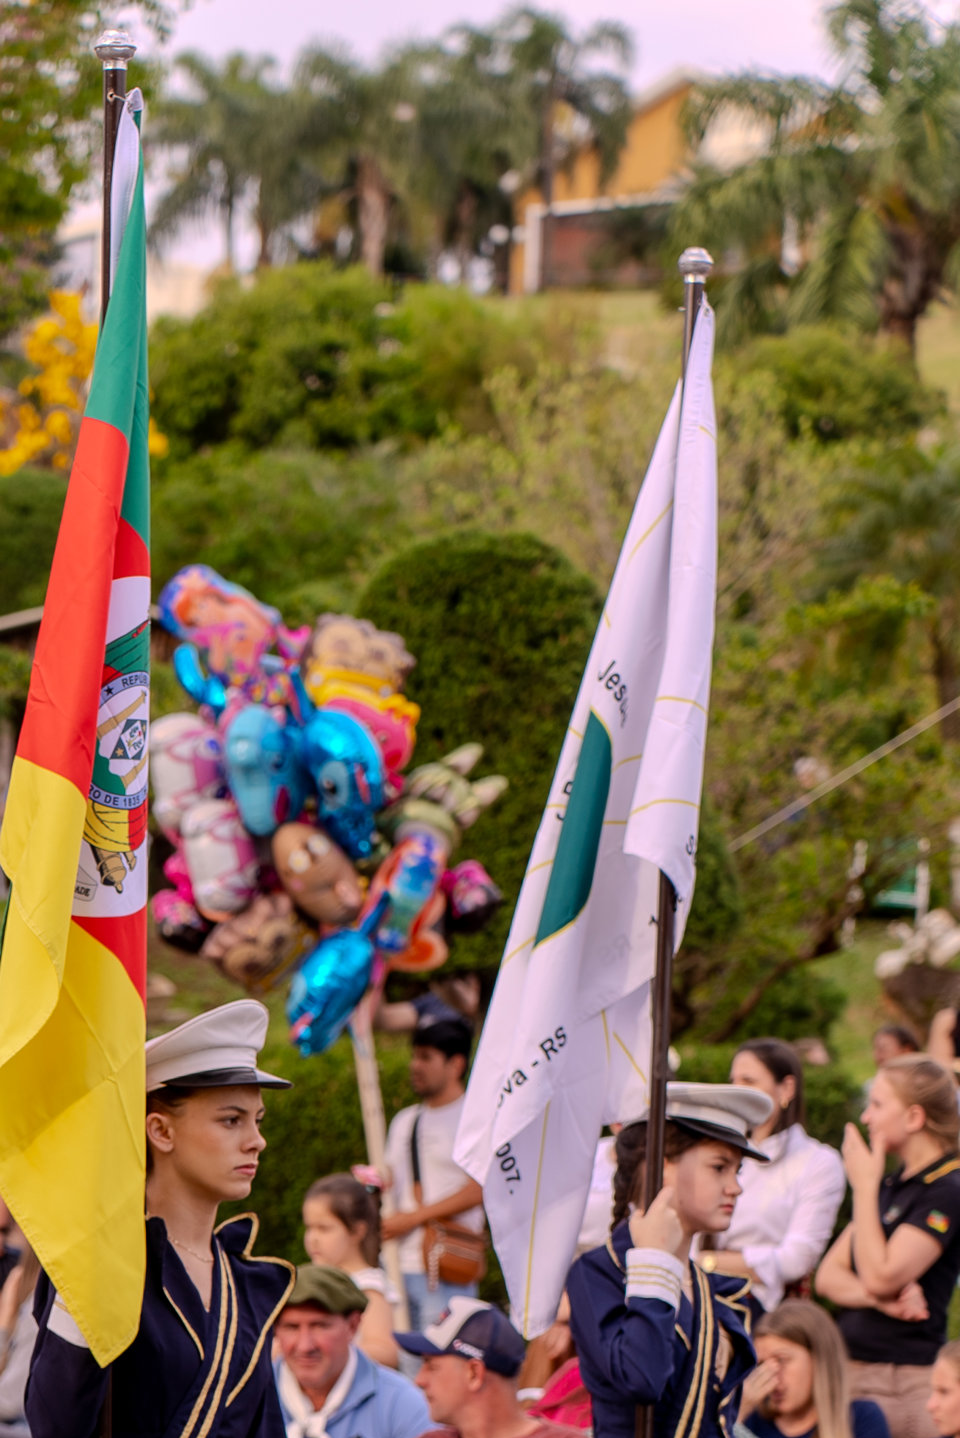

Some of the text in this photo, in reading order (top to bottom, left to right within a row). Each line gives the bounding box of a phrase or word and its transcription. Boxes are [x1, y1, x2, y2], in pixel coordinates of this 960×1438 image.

[104, 794, 120, 806] DE
[123, 795, 141, 807] 1835
[539, 1026, 567, 1061] RS
